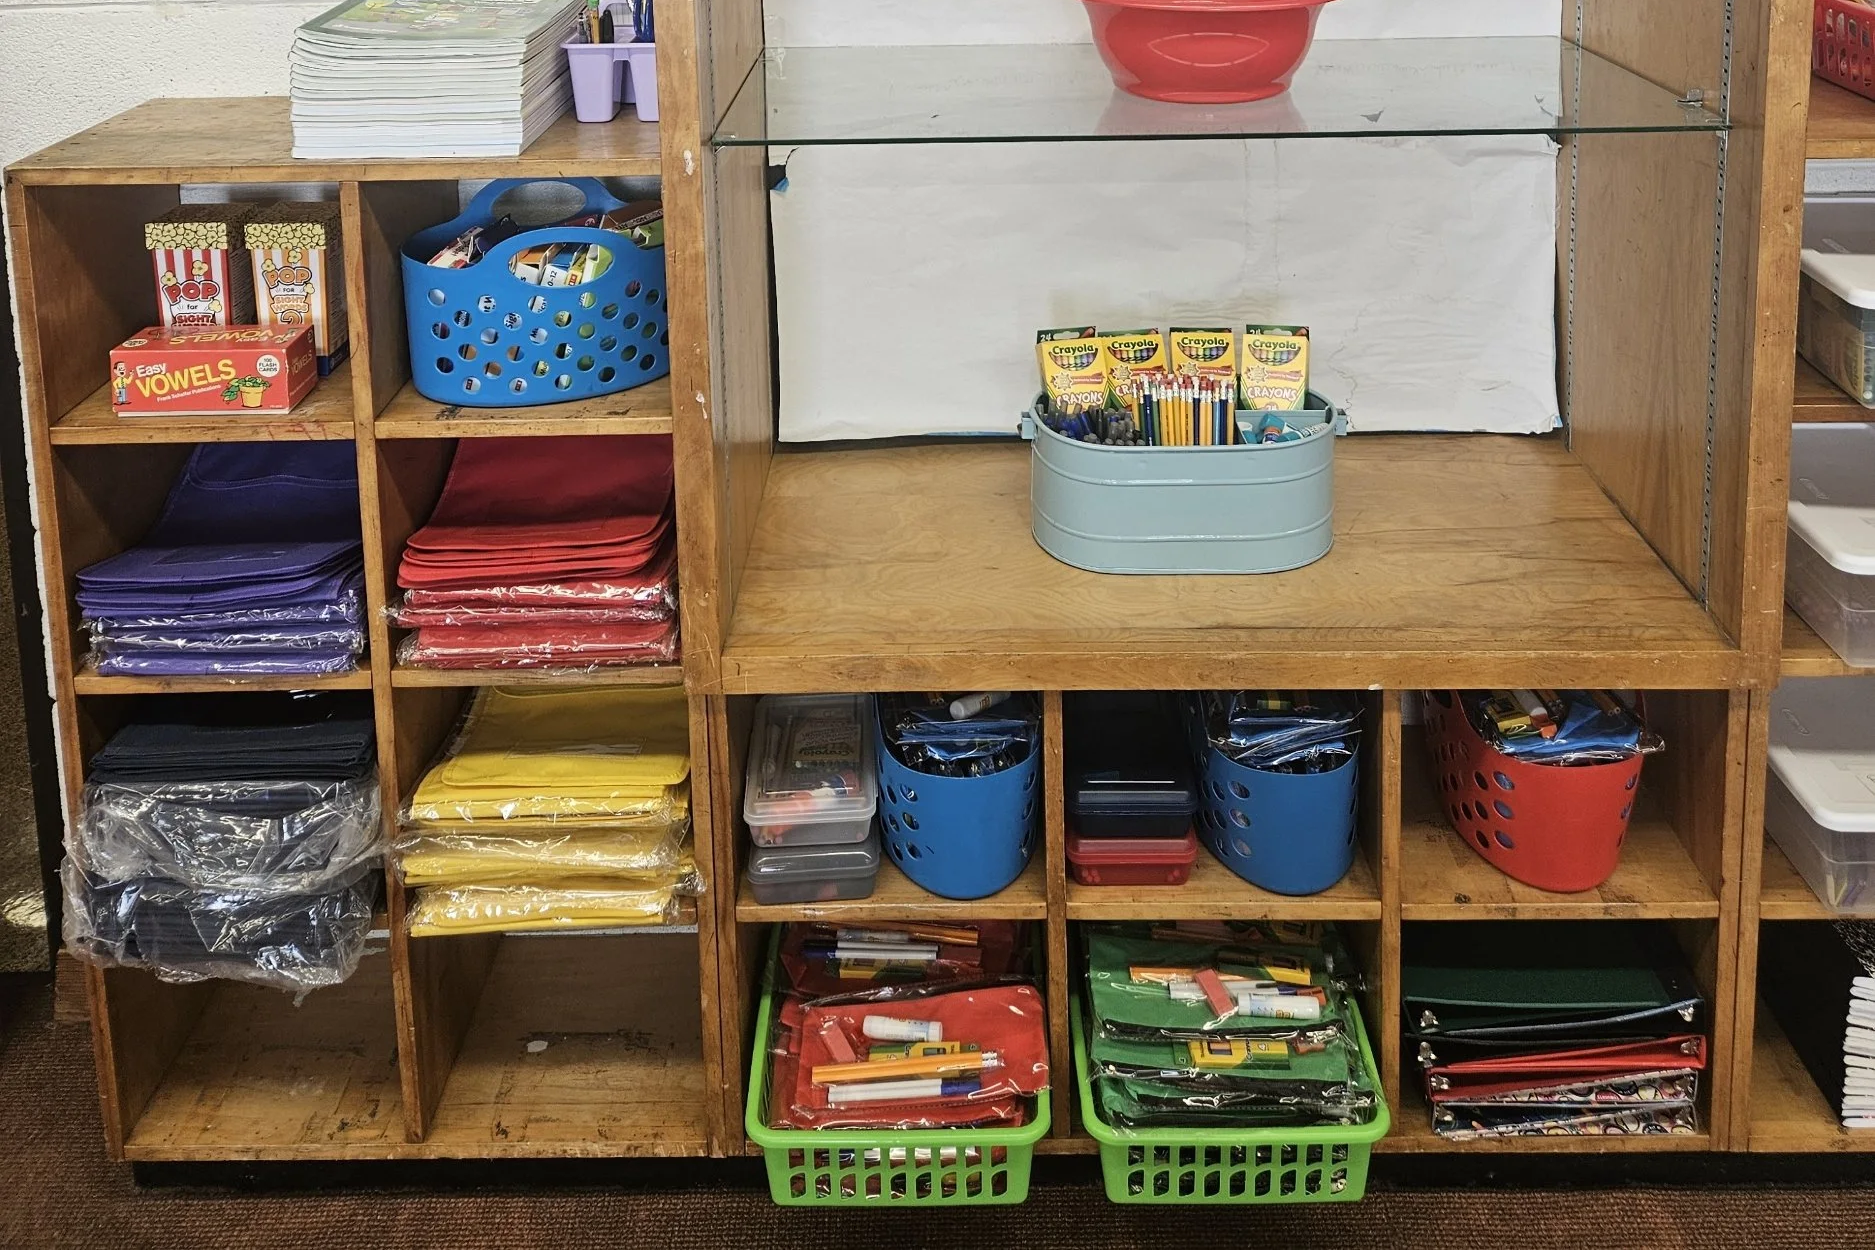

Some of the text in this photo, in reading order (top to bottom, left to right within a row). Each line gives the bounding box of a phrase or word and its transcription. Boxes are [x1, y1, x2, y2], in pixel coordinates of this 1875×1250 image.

[262, 266, 312, 288] POP
[162, 280, 220, 306] POP
[273, 303, 307, 311] WORDS
[175, 313, 212, 323] SIGHT
[169, 329, 274, 345] VOWELS
[1040, 333, 1051, 342] 24
[1181, 336, 1225, 347] Crayola
[1052, 344, 1094, 355] Crayola
[1111, 339, 1154, 349] Crayola
[1252, 339, 1297, 350] Crayola
[136, 363, 166, 377] Easy
[135, 359, 236, 397] VOWELS
[1056, 391, 1103, 406] CRAYONS
[1247, 386, 1298, 401] CRAYONS
